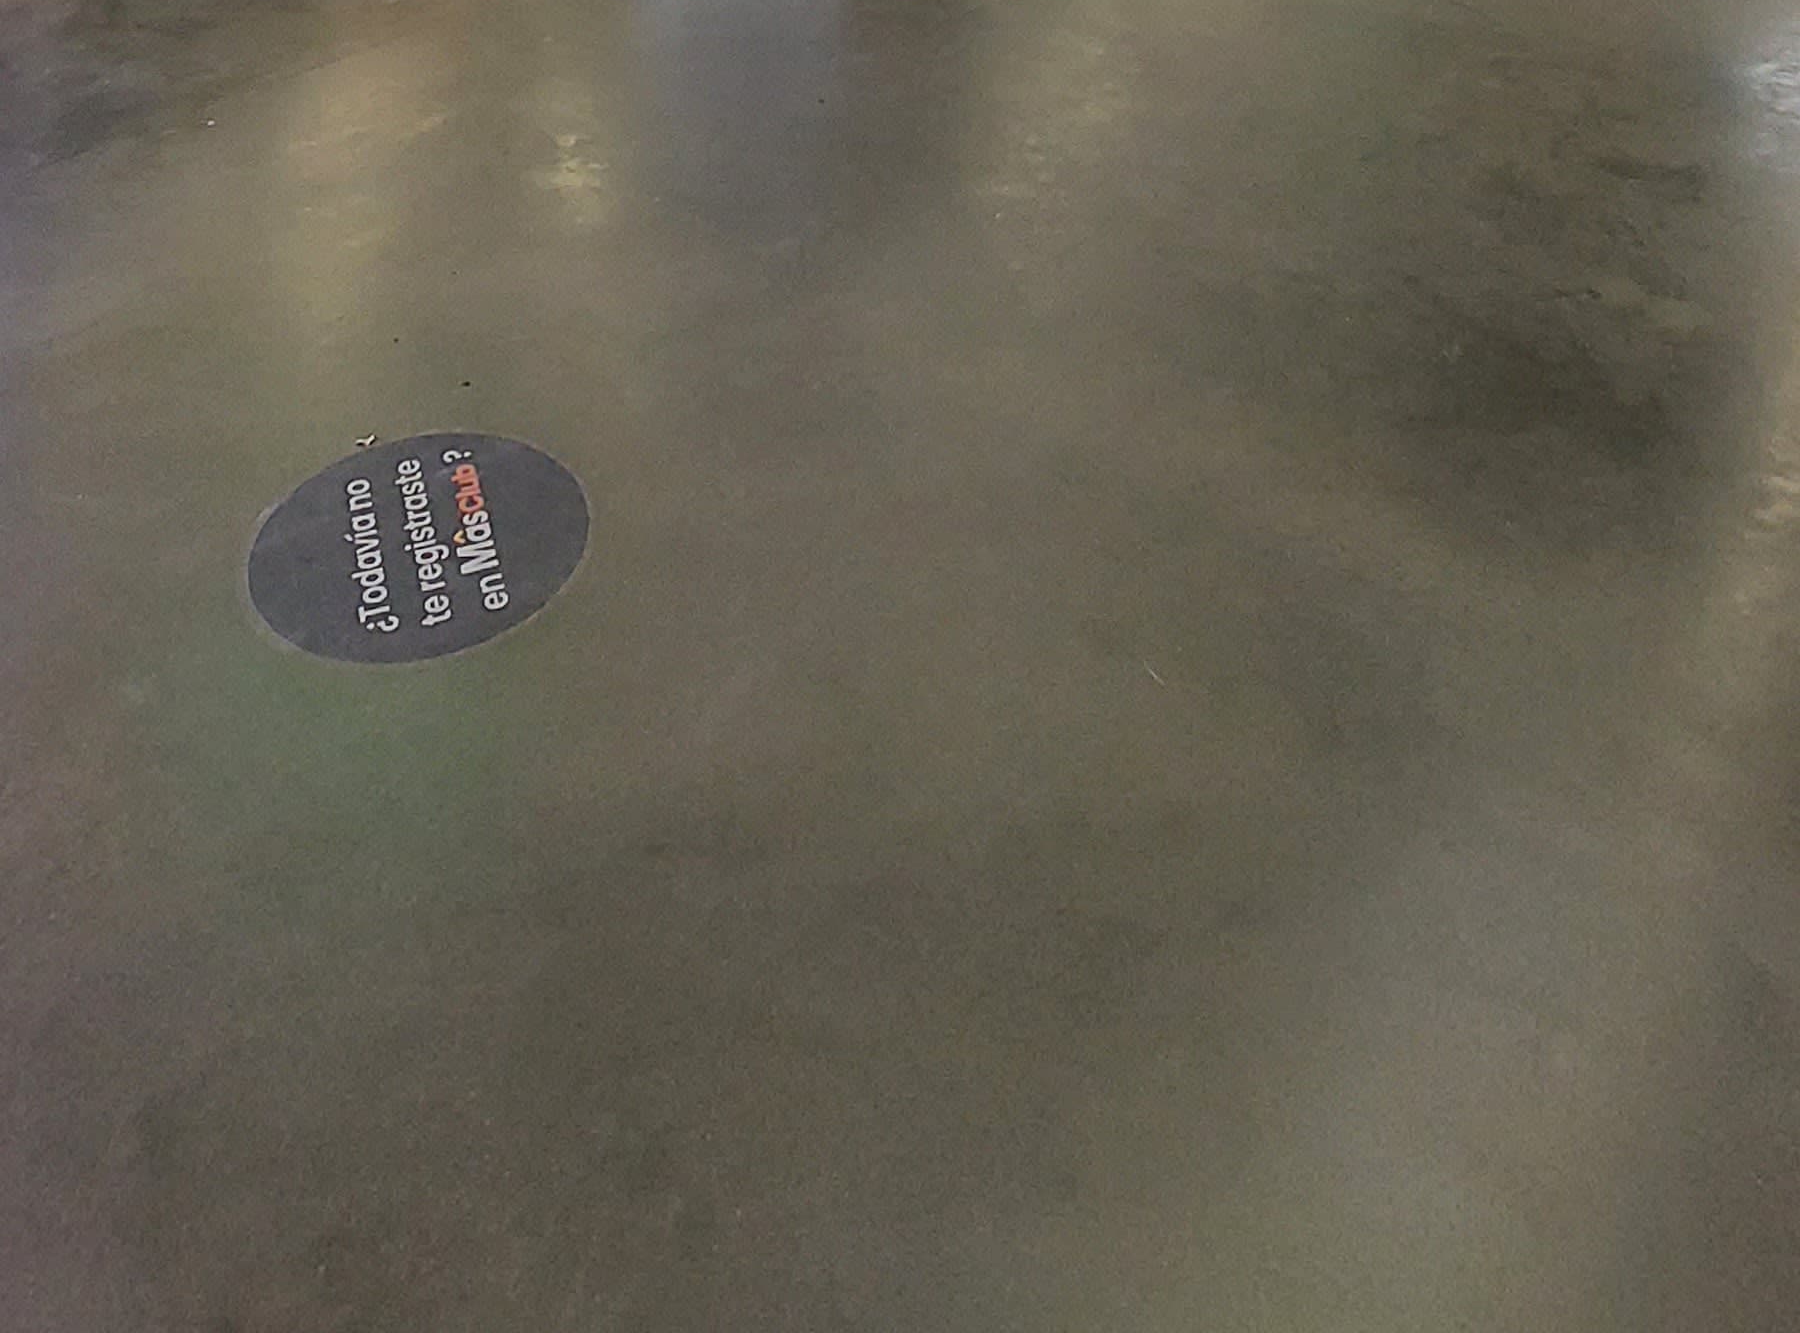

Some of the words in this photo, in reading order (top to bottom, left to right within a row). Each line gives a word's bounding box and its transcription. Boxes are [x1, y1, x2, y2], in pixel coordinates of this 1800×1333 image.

[347, 478, 373, 512] no
[395, 458, 450, 592] registraste
[344, 512, 400, 633] ¿Todavía
[479, 572, 509, 611] en
[421, 593, 453, 627] te
